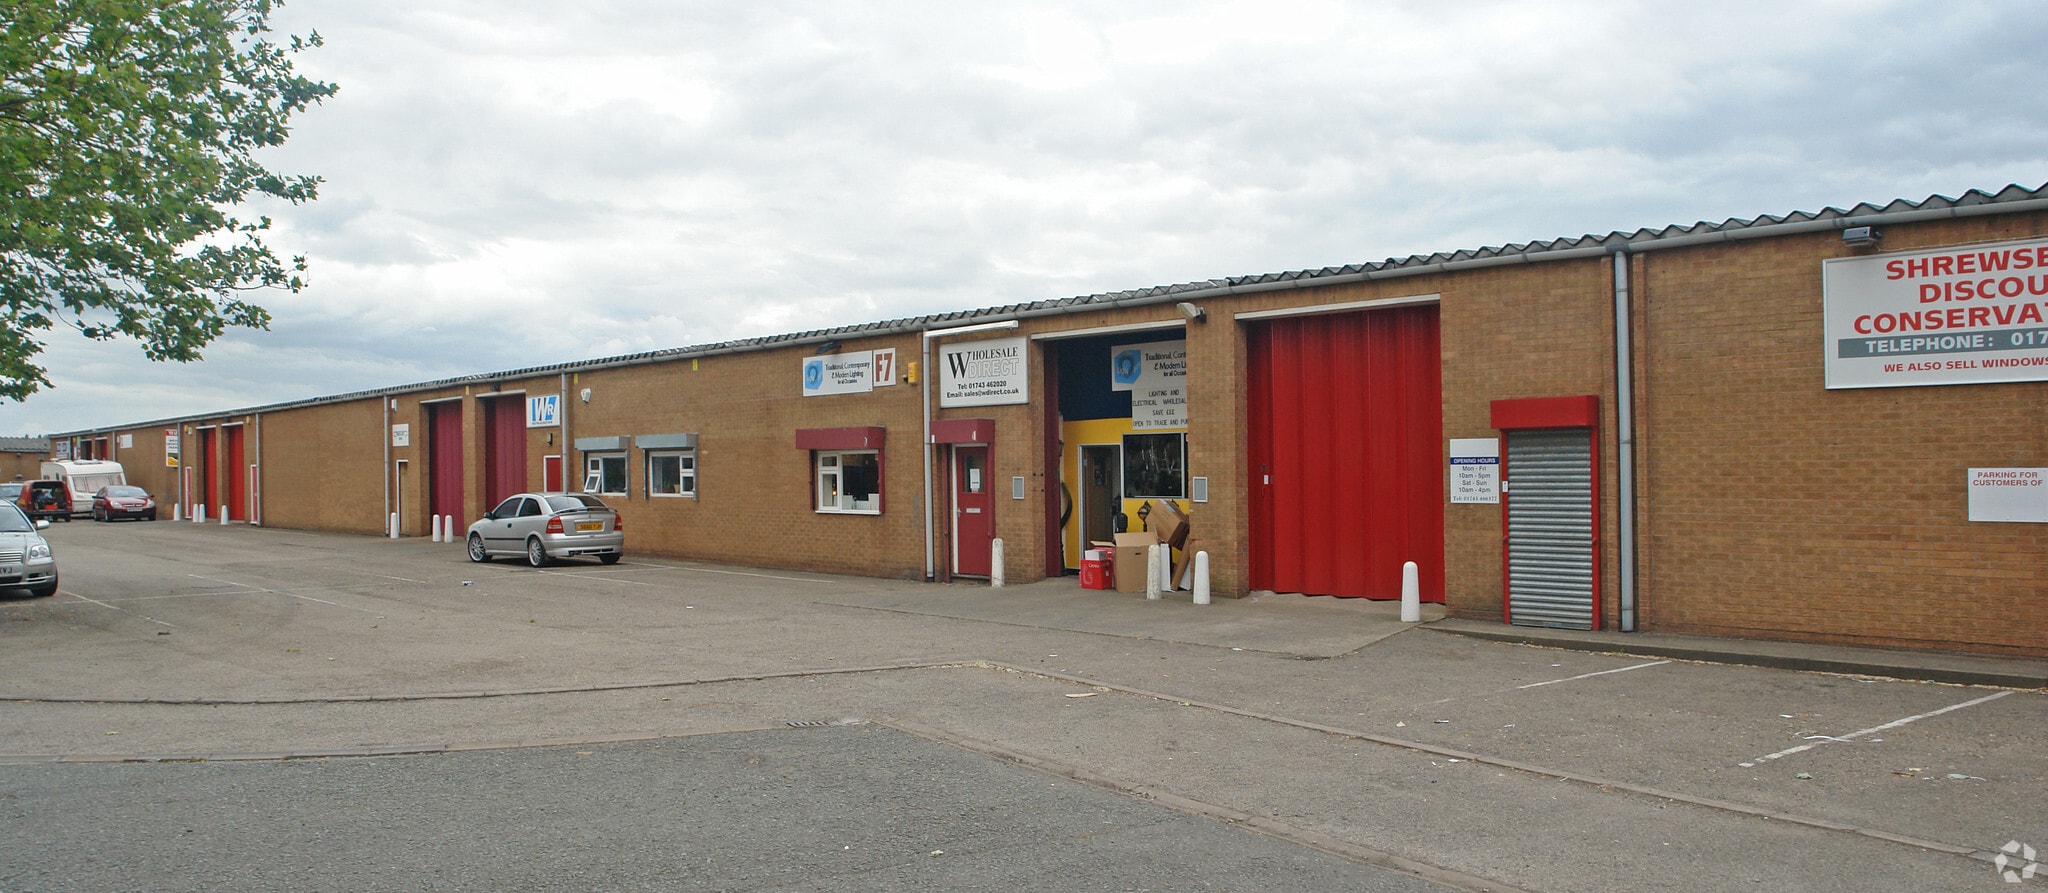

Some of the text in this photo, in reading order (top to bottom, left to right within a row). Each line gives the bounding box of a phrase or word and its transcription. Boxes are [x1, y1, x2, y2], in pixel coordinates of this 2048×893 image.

[1919, 274, 2048, 304] DISCOU
[1853, 302, 2048, 335] CONSERVA
[2010, 330, 2048, 346] 017
[875, 352, 893, 383] F7
[947, 346, 1018, 379] WHOLESALE
[969, 358, 1019, 379] DIRECT
[1160, 362, 1180, 370] Modern
[1884, 363, 1904, 373] WE
[1907, 361, 1942, 371] ALSO
[1945, 359, 1978, 370] SELL
[986, 380, 1007, 388] 462020
